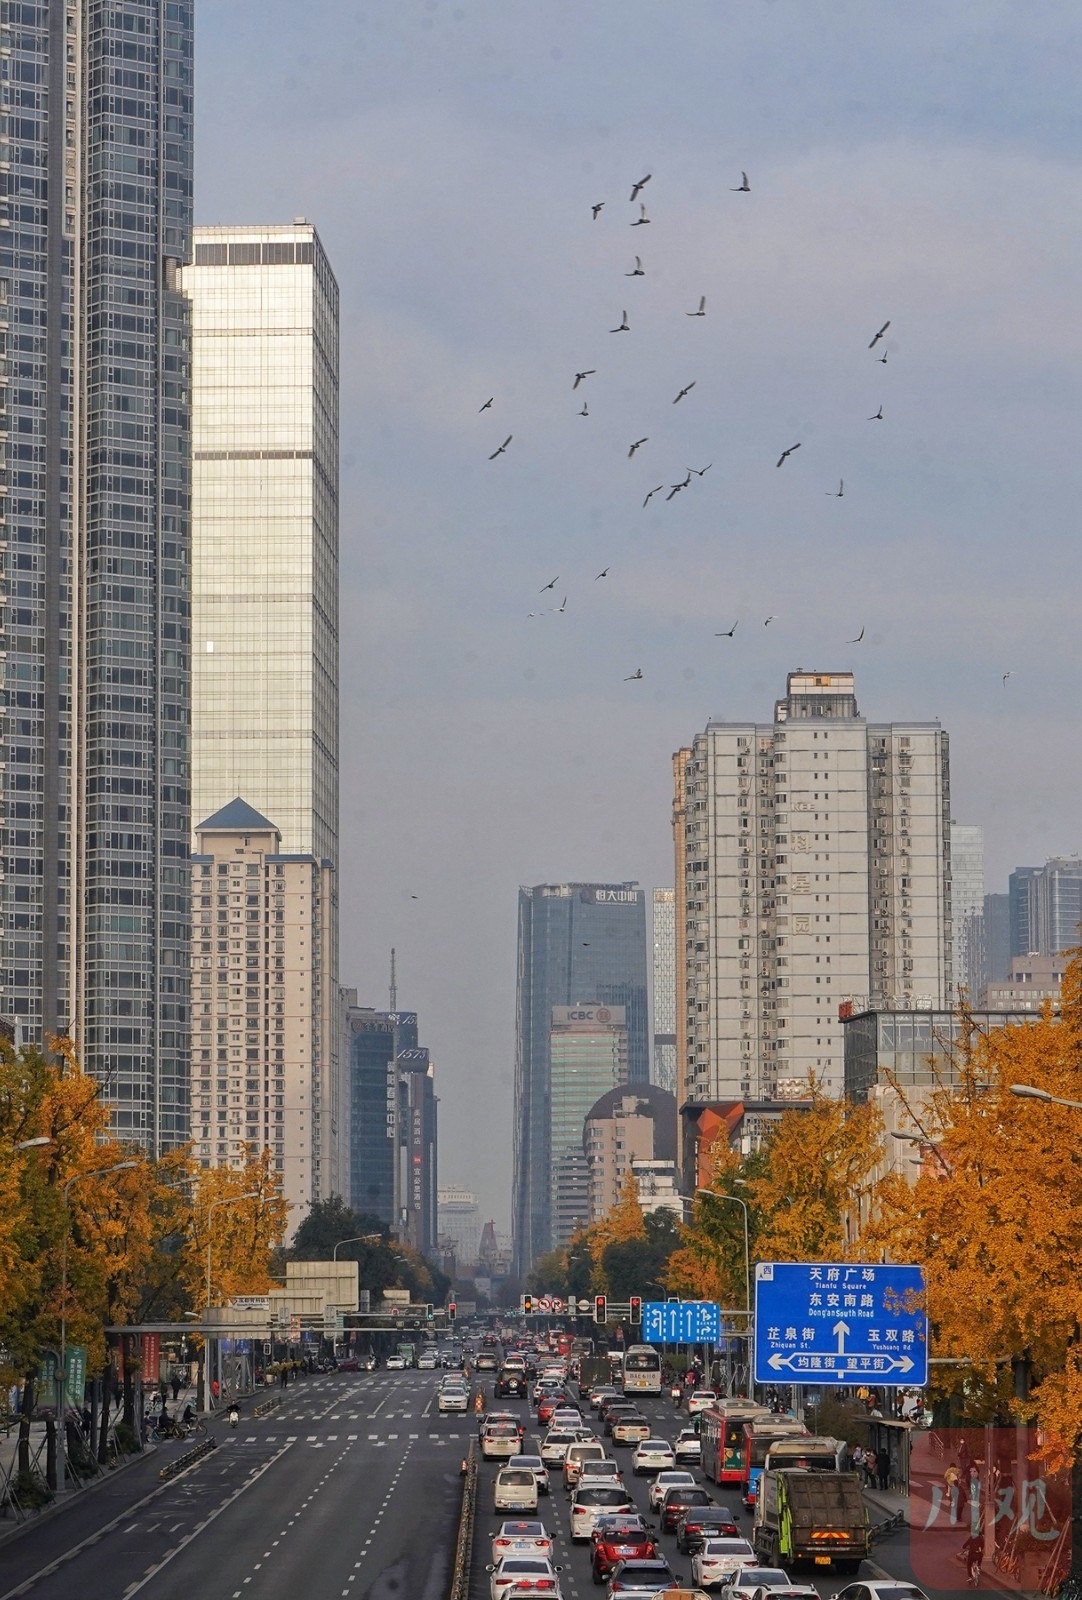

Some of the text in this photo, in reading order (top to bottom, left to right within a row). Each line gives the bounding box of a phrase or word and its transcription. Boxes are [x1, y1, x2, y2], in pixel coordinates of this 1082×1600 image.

[595, 889, 638, 902] 恒大中心
[567, 1011, 594, 1020] ICBC
[397, 1048, 426, 1059] 1573
[763, 1265, 772, 1275] 西
[809, 1268, 876, 1281] 天府广场
[809, 1293, 874, 1307] 东安南路
[858, 1309, 874, 1318] Road
[767, 1327, 816, 1341] 芷泉街
[867, 1329, 915, 1343] 玉双路
[797, 1356, 885, 1370] 均隆街 望平街
